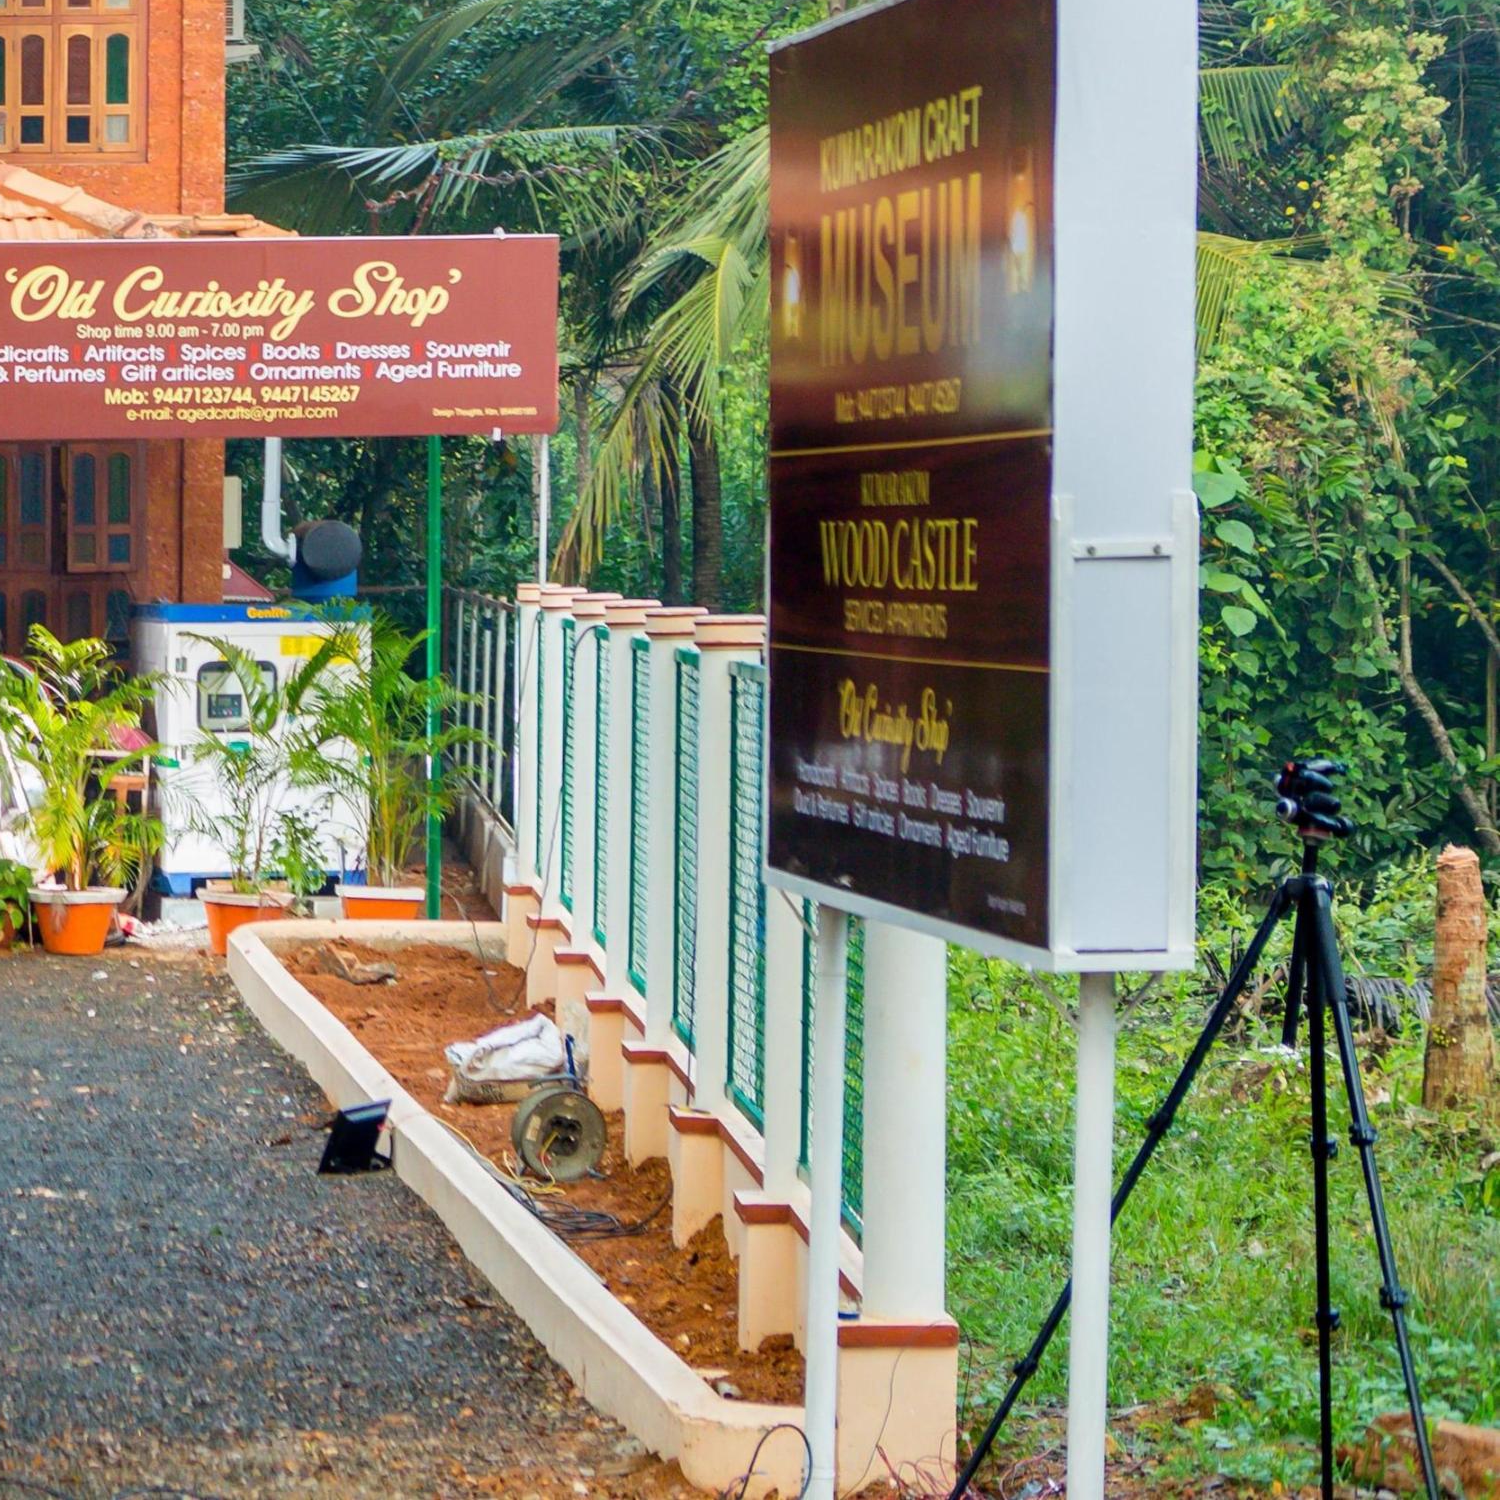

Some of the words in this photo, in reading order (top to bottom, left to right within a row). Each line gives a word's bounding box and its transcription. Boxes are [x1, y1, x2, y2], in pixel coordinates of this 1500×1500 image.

[818, 107, 921, 195] KUMARAKOM
[922, 84, 983, 164] CRAFT
[819, 171, 982, 368] MUSEUM
[112, 265, 315, 342] Curiosity
[76, 323, 112, 341] Shop
[114, 324, 143, 338] time
[145, 323, 176, 338] 9.00
[178, 325, 199, 337] am
[211, 323, 240, 338] 7.00
[242, 325, 265, 340] pm
[84, 344, 165, 362] Artifacts
[180, 342, 246, 364] Spices
[262, 342, 320, 361] Books
[335, 342, 411, 360] Dresses
[426, 340, 512, 358] Souvenir
[13, 365, 106, 383] Perfumes
[121, 364, 158, 381] Gift
[162, 364, 235, 382] articles
[250, 363, 361, 381] Ornaments
[375, 362, 432, 382] Aged
[437, 360, 522, 378] Furniture
[104, 388, 149, 405] Mob:
[152, 386, 257, 405] 9447123744,
[260, 385, 361, 403] 9447145267
[126, 406, 174, 421] e-mail:
[176, 404, 338, 423] agedcrafts@gmail.com
[819, 518, 890, 588] WOOD
[891, 516, 979, 591] CASTLE
